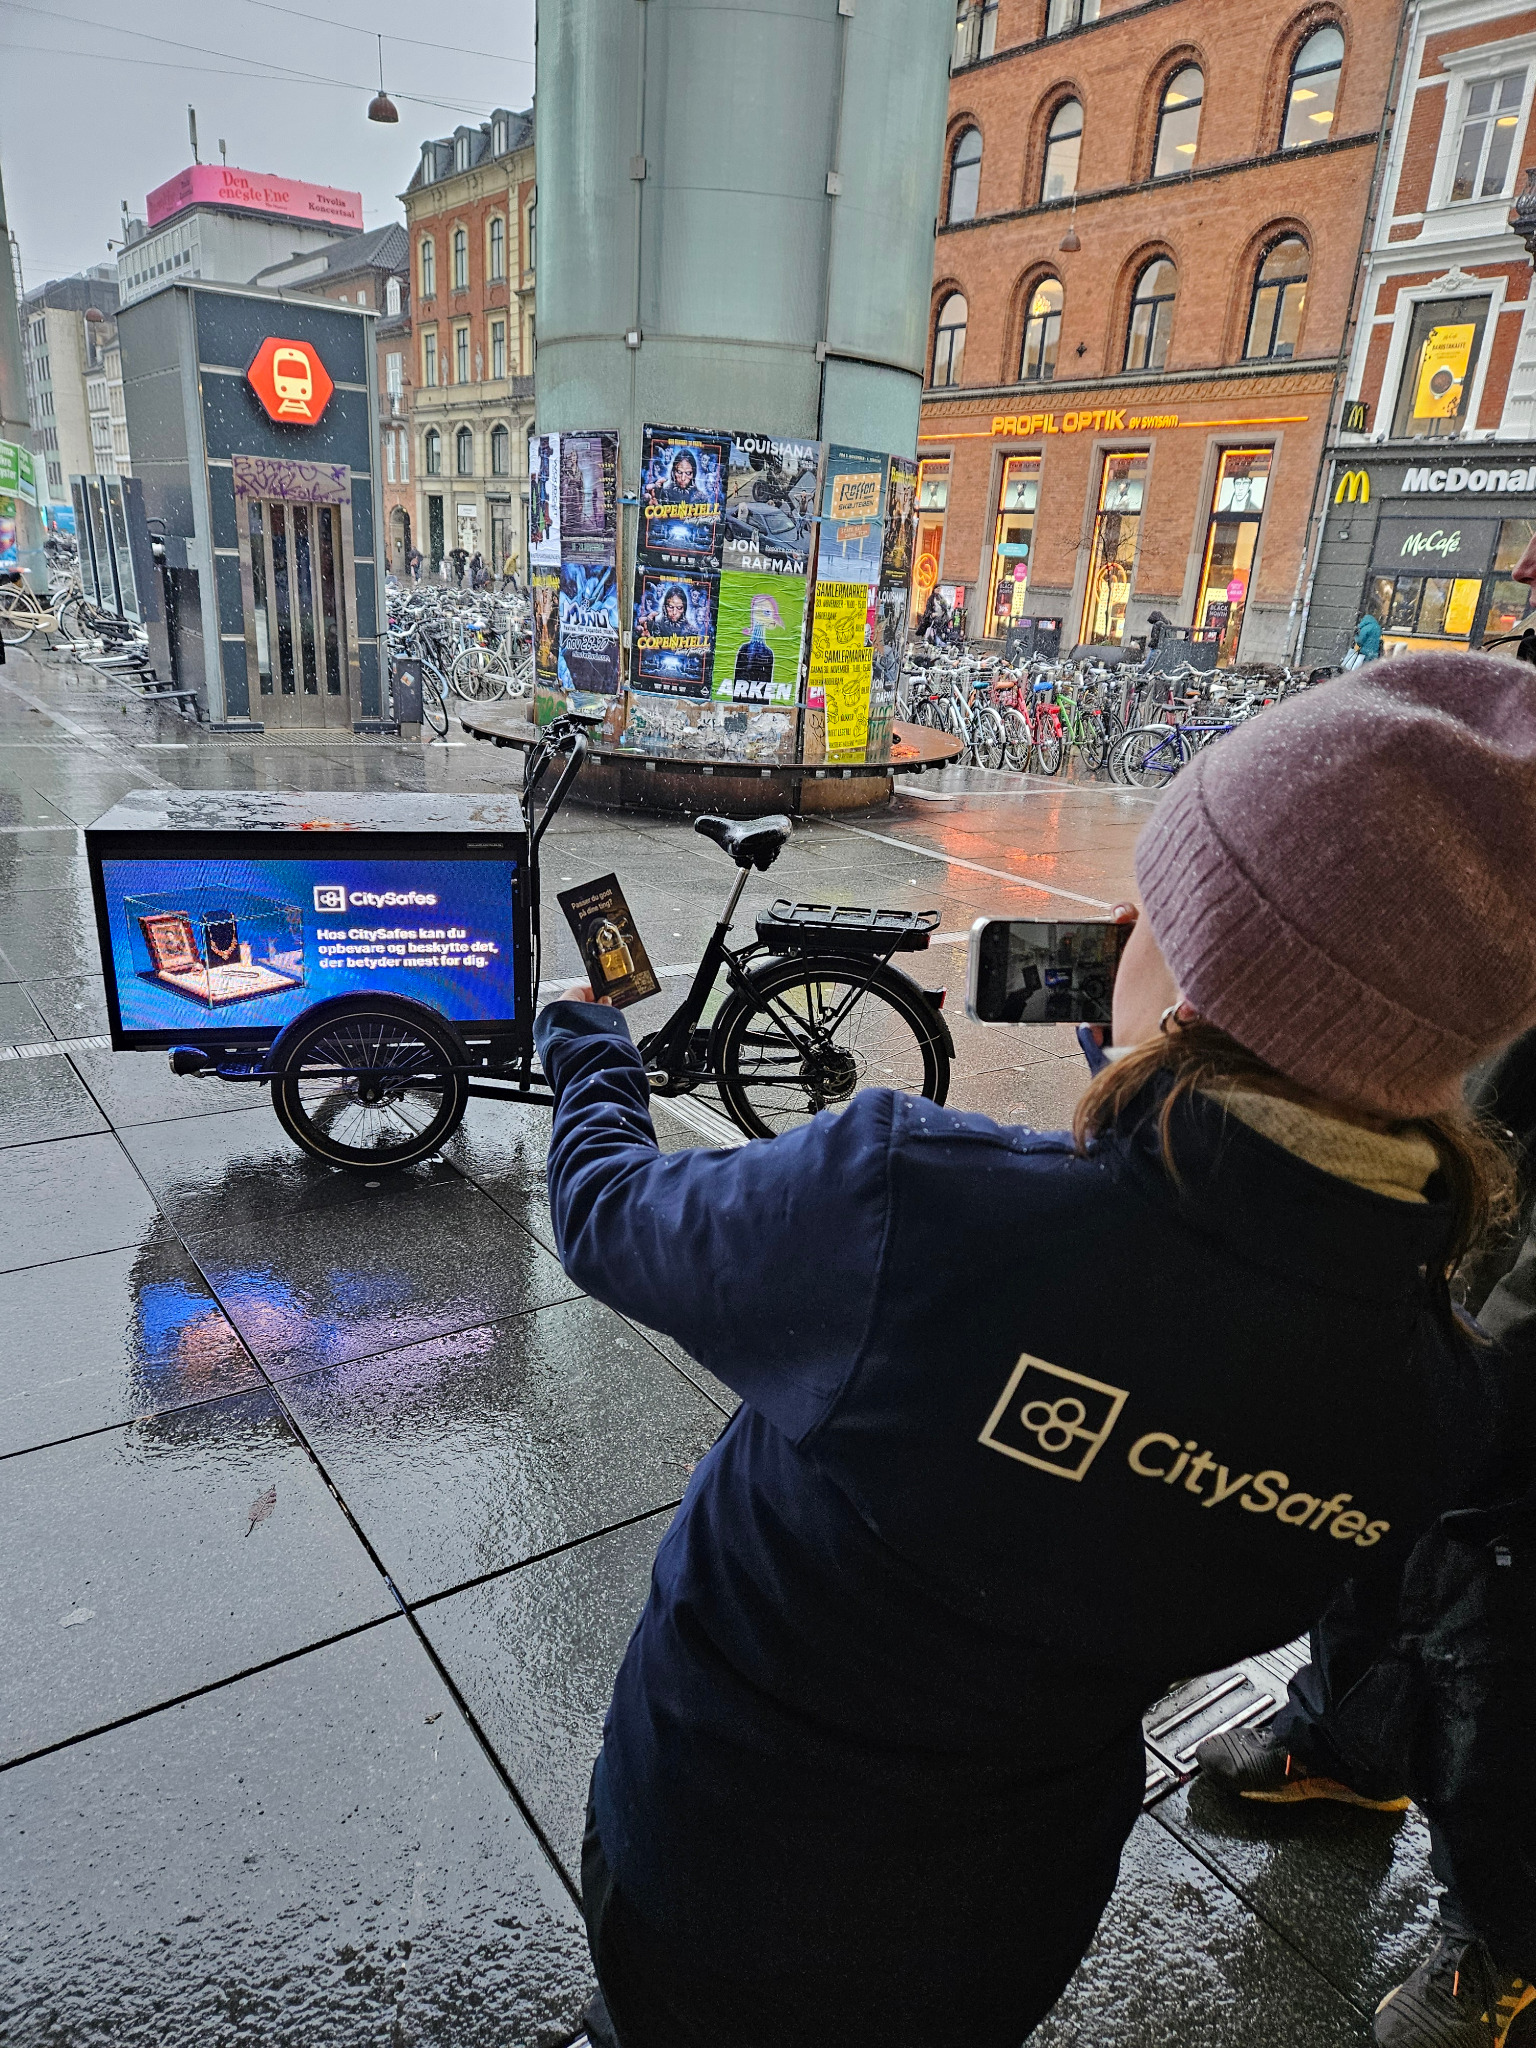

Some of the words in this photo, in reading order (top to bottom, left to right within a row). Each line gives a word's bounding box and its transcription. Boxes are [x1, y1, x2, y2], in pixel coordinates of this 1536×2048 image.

[222, 171, 250, 188] Den
[218, 186, 263, 202] eneste
[264, 188, 291, 204] Ene
[316, 194, 347, 208] Tivolis
[308, 201, 356, 219] Koncertsal
[991, 413, 1060, 437] PROFIL
[1062, 408, 1128, 433] OPTIK
[1129, 416, 1142, 430] BY
[1142, 414, 1179, 429] SYNSAM
[736, 436, 814, 460] LOUISIANA
[1401, 466, 1536, 493] McDonal
[645, 499, 721, 520] COPENHELL
[728, 538, 760, 554] JON
[1400, 529, 1461, 559] McCafé
[741, 556, 804, 575] RAFMAN
[1210, 604, 1229, 612] BLACK
[637, 632, 711, 651] COPENHELL
[716, 678, 793, 701] ARKEN
[349, 891, 438, 908] CitySafes
[571, 896, 591, 910] Passer
[591, 893, 600, 901] du
[598, 888, 613, 900] godt
[578, 910, 588, 919] på
[586, 905, 599, 915] dine
[598, 898, 613, 910] ting?
[317, 929, 346, 940] Hos
[348, 928, 418, 942] CitySafes
[419, 928, 446, 939] kan
[447, 928, 466, 939] du
[318, 943, 388, 956] opbevare
[389, 945, 405, 955] og
[408, 941, 469, 955] beskytte
[470, 941, 499, 954] det,
[319, 957, 344, 968] der
[346, 956, 401, 969] betyder
[403, 956, 440, 967] mest
[440, 955, 461, 966] for
[462, 955, 489, 969] dig.
[1128, 1431, 1391, 1547] CitySafes
